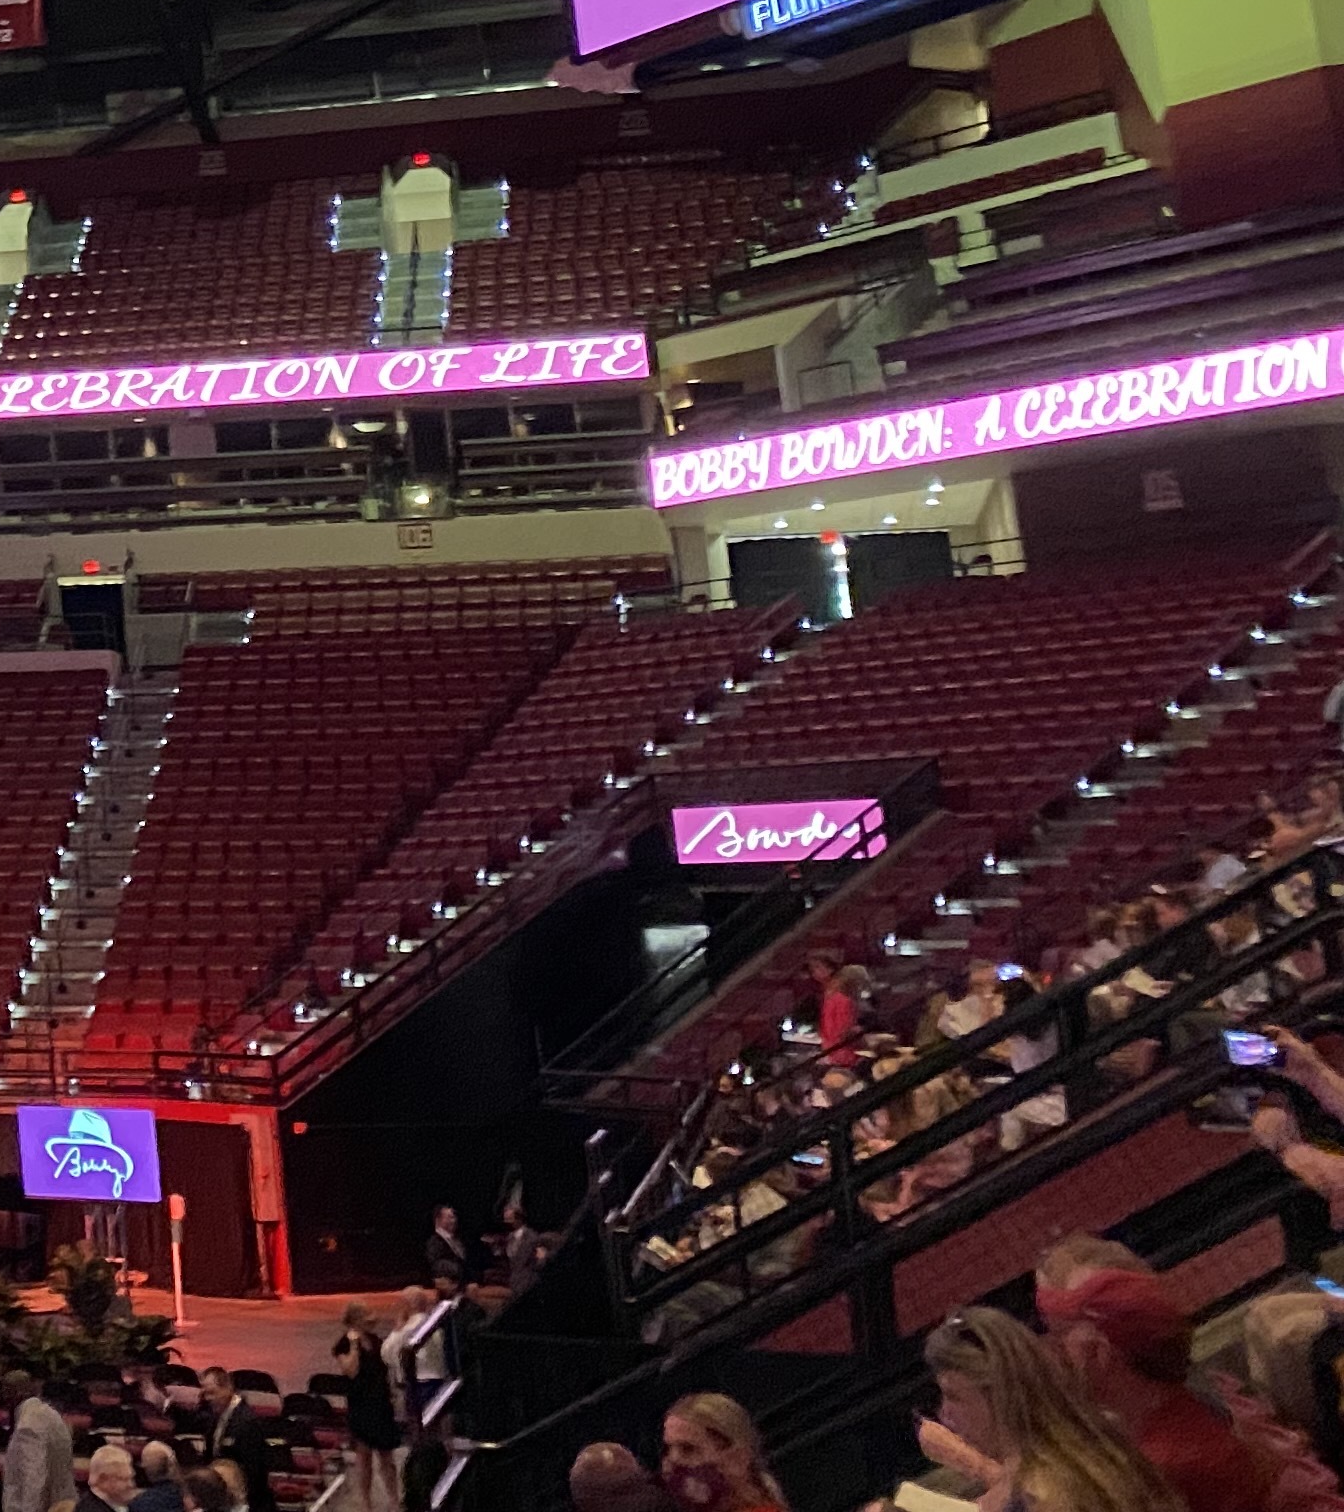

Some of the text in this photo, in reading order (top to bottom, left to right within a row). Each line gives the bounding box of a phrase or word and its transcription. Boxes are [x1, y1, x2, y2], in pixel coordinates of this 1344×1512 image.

[377, 346, 472, 391] OF
[478, 334, 645, 383] LIFE
[654, 335, 1330, 501] BOBBY BOWDEN: A CELEBRATION
